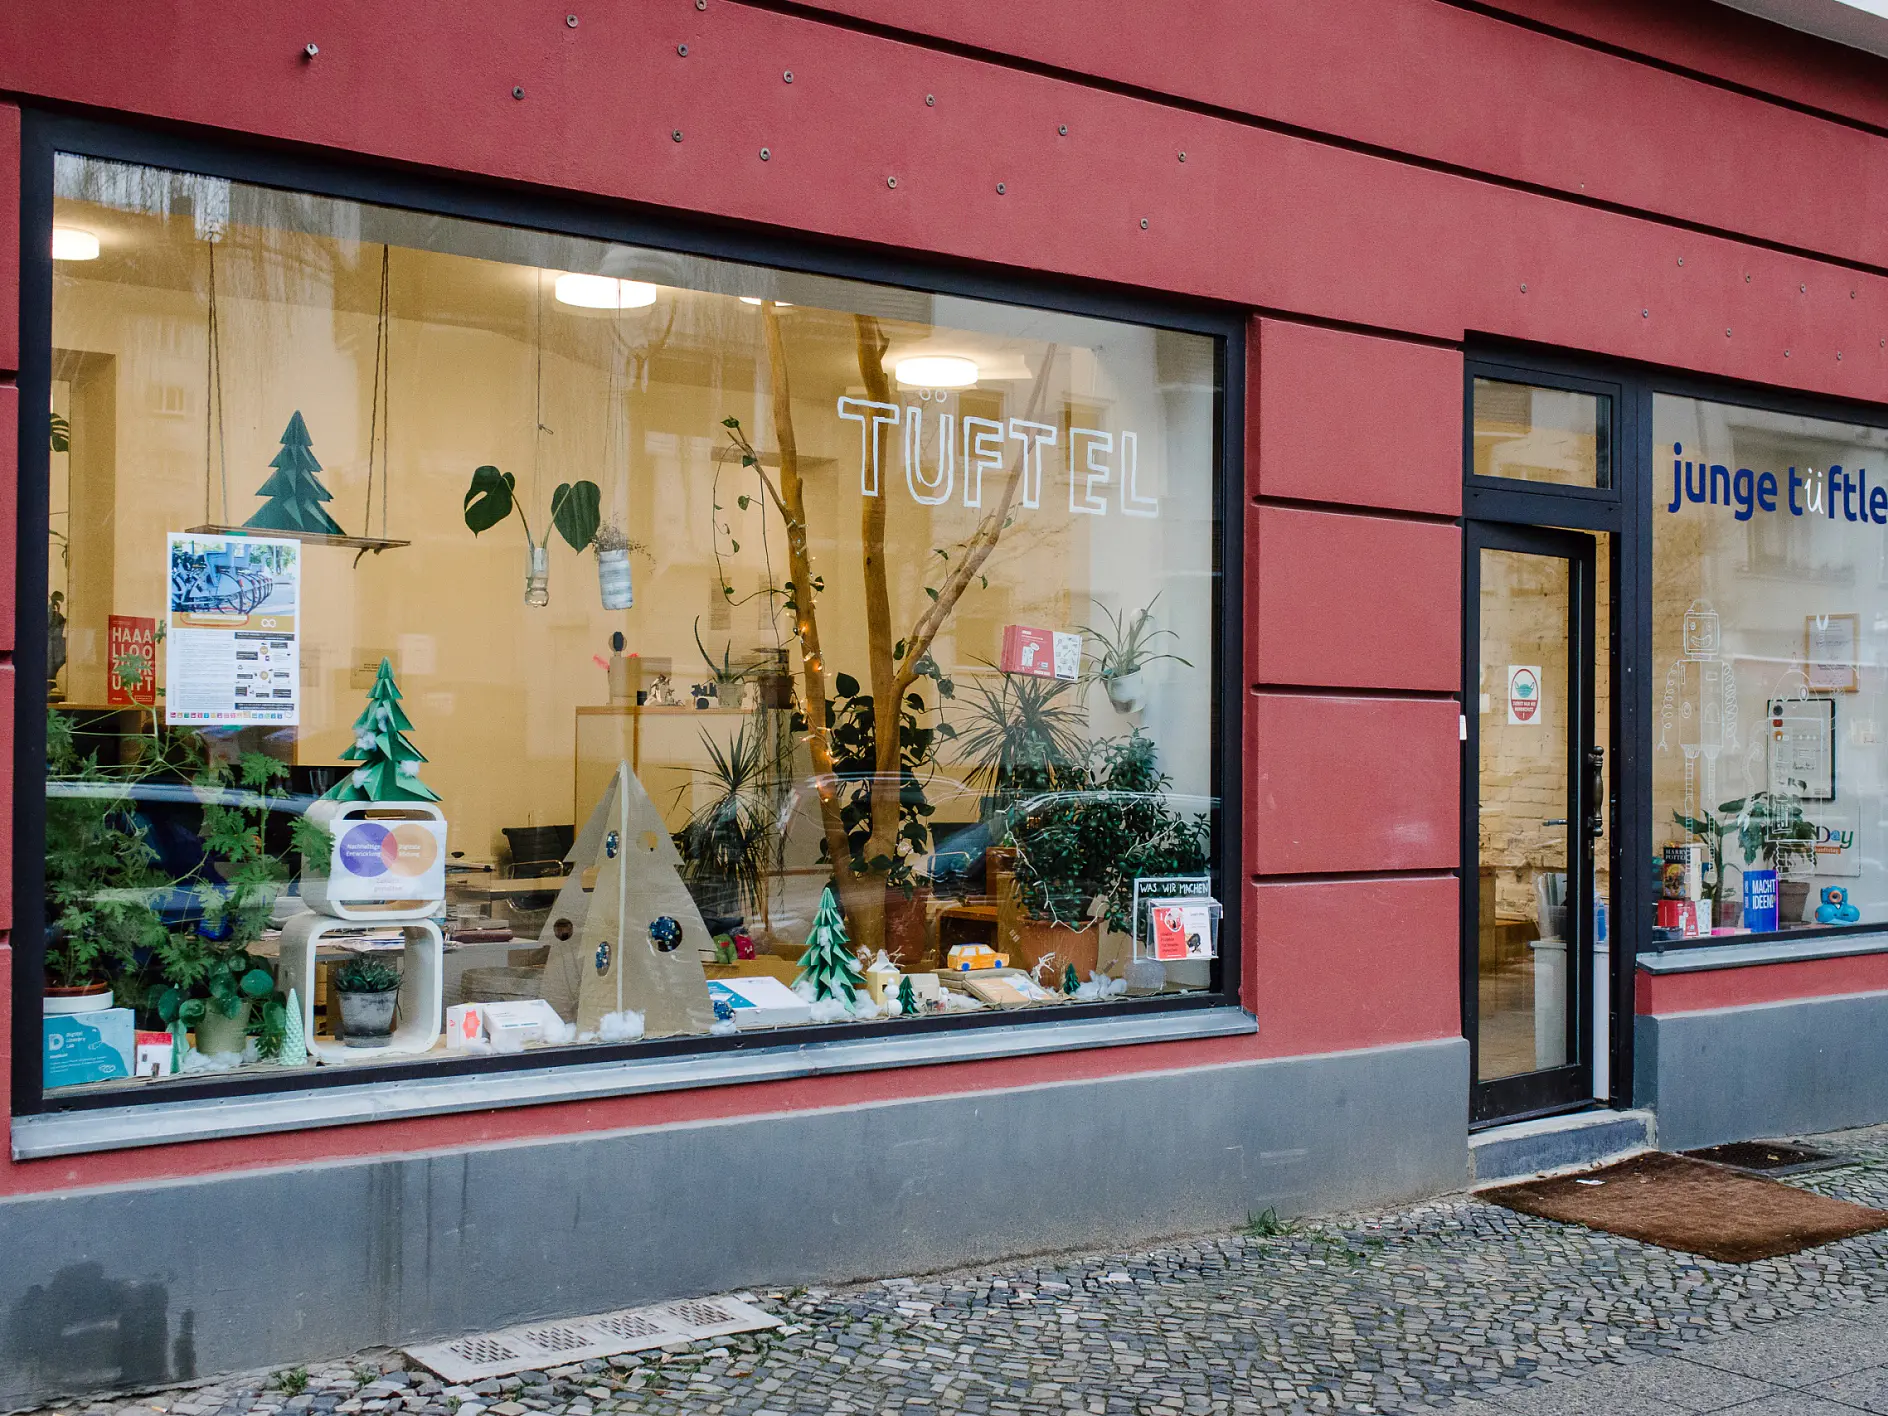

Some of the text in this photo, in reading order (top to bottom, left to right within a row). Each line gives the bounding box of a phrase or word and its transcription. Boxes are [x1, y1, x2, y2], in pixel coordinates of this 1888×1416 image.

[837, 388, 1158, 518] TÜFTEL
[1668, 442, 1888, 525] junge tüftle
[112, 626, 153, 643] HAAA
[112, 643, 153, 660] LLOO
[1816, 826, 1854, 849] Day
[1140, 882, 1209, 894] WAS WIR MACHEN
[1752, 879, 1776, 894] MACHT
